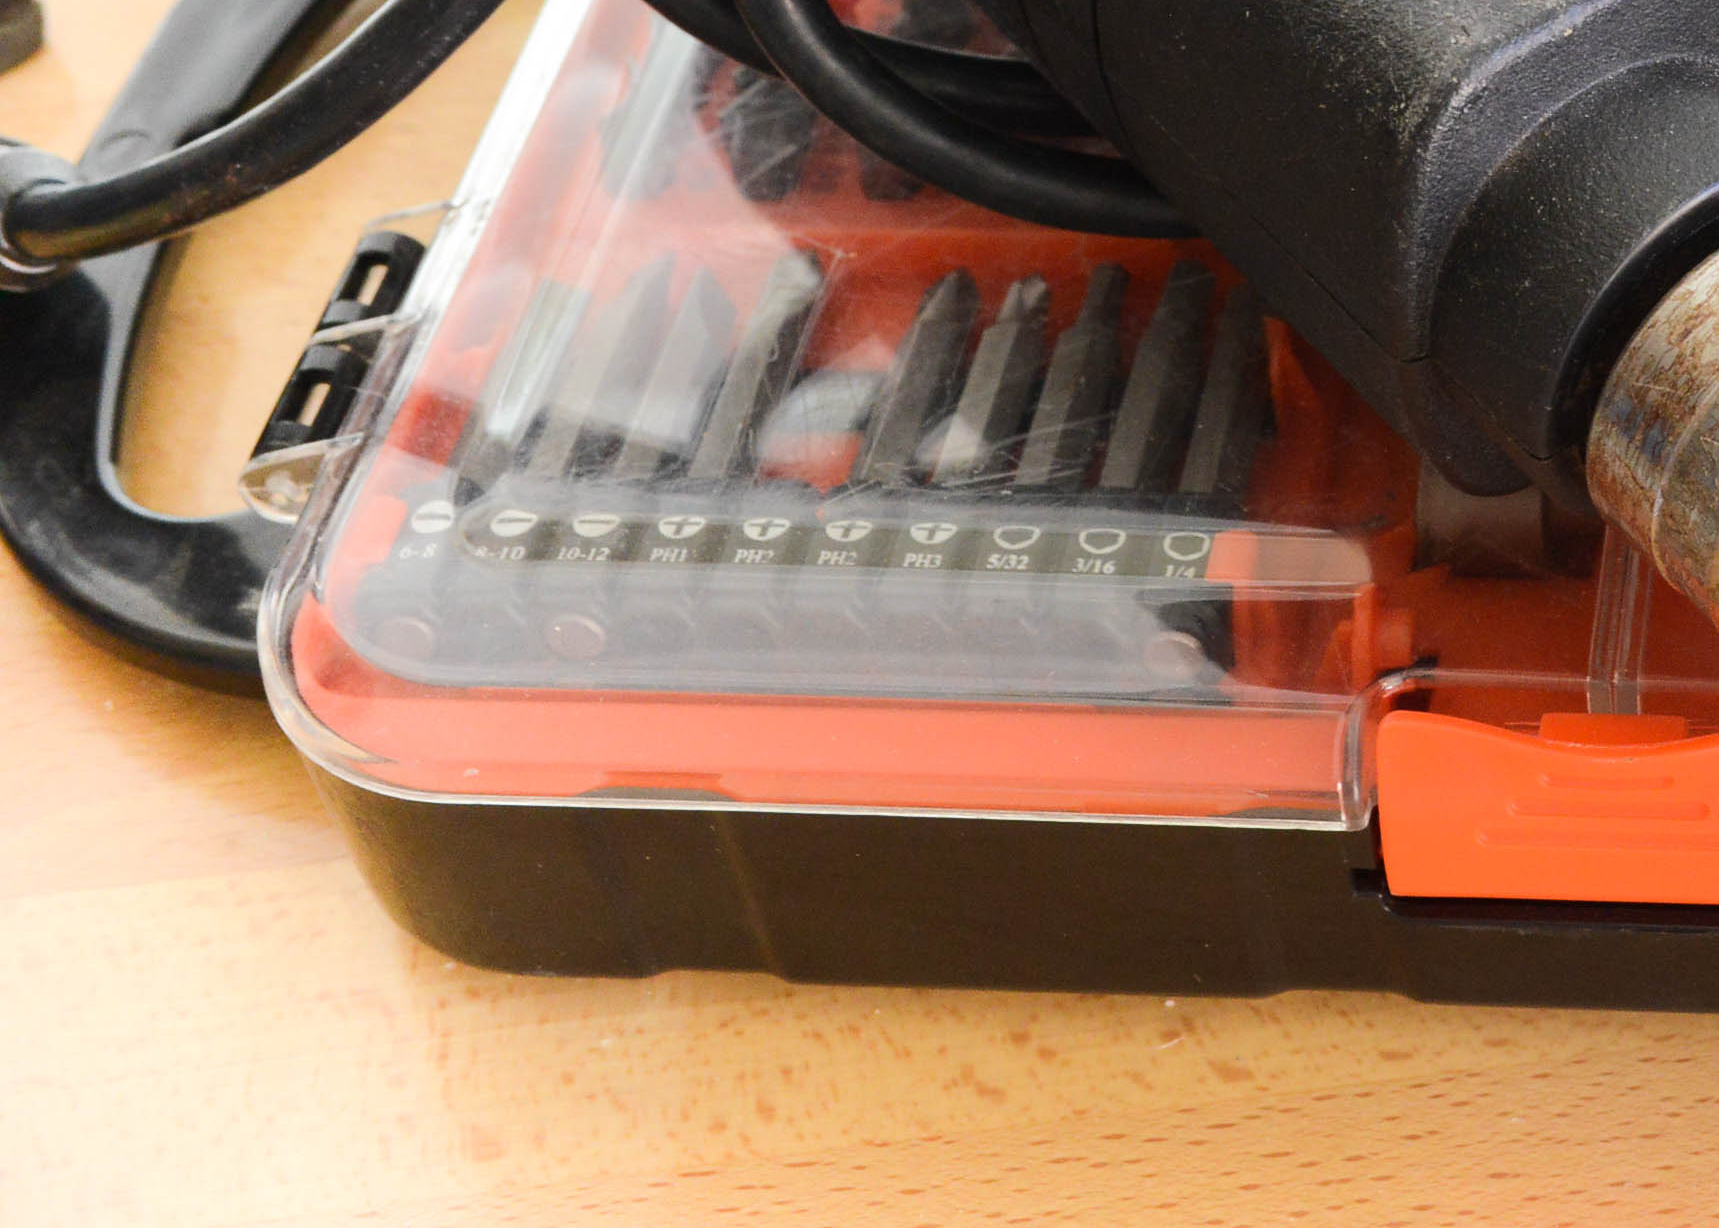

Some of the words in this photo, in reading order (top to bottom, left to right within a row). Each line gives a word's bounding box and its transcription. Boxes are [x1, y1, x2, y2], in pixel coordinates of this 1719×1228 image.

[557, 547, 610, 561] 10-12
[650, 547, 688, 562] PH1
[817, 550, 857, 566] PH2
[902, 552, 948, 568] PH3
[986, 554, 1030, 570] 5/32
[1072, 558, 1117, 574] 3/16
[1165, 565, 1197, 579] 1/4
